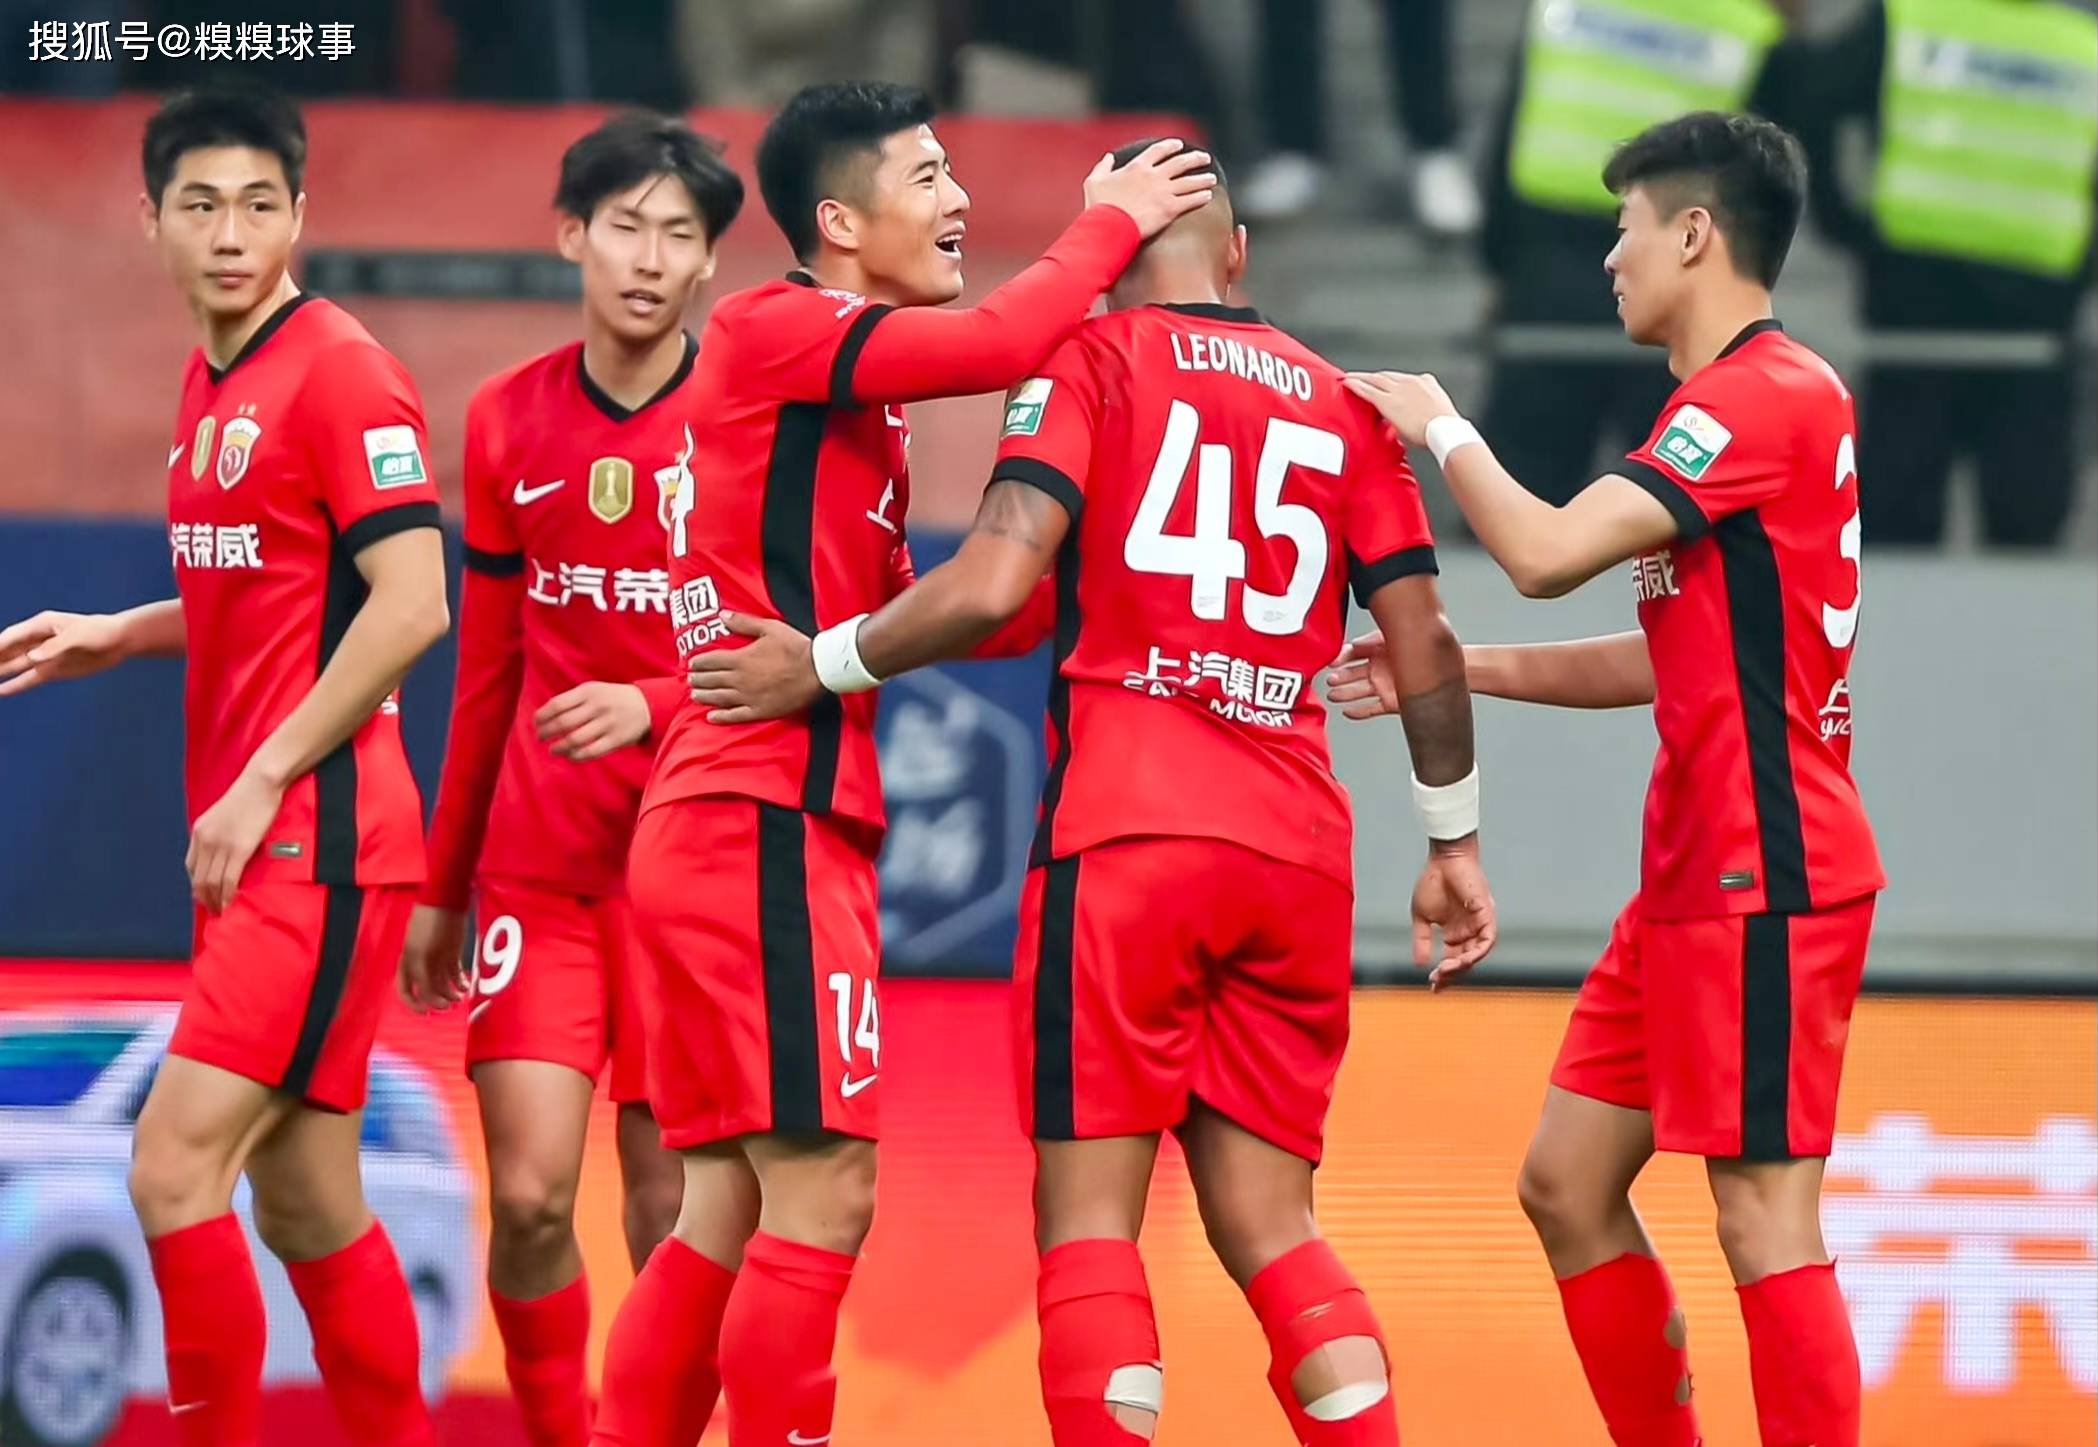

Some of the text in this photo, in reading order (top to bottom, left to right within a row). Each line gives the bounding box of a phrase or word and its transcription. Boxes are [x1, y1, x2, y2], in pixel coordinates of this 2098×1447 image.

[1170, 332, 1313, 402] LEONARDO
[1123, 398, 1346, 636] 45
[1125, 646, 1303, 711] 上汽集团
[827, 971, 880, 1069] 14
